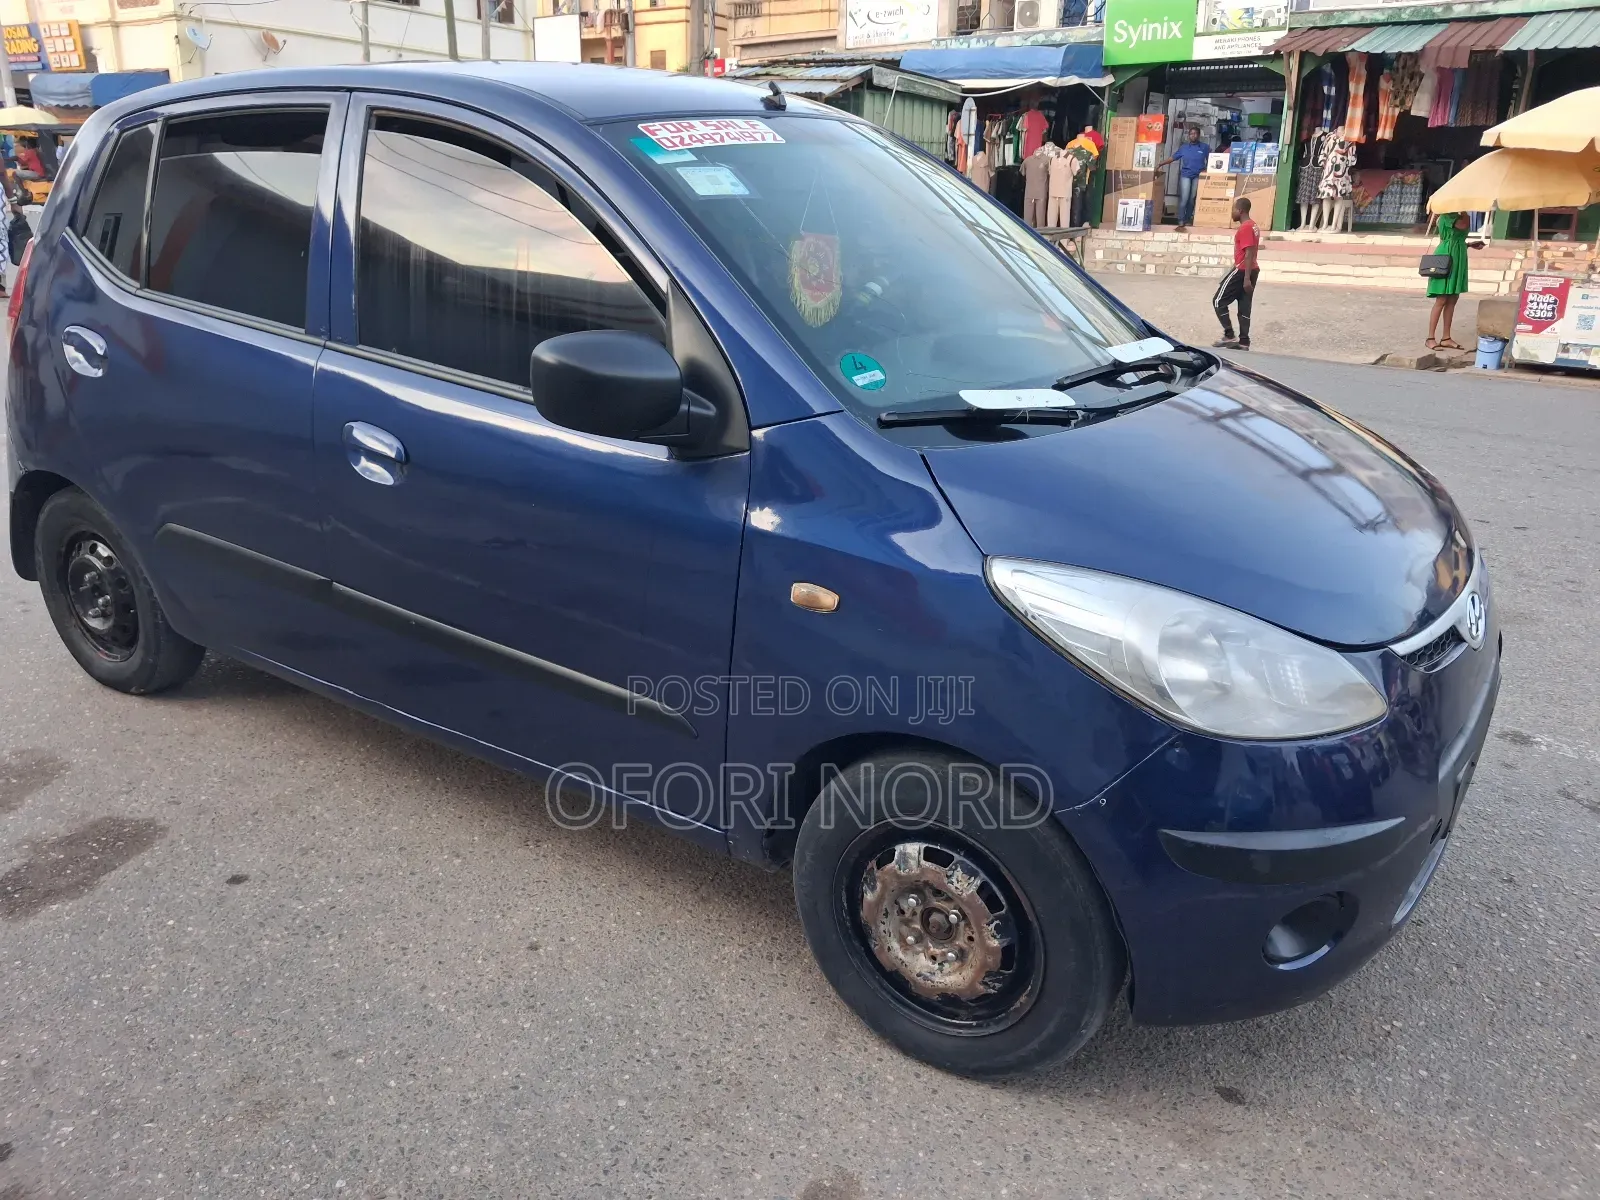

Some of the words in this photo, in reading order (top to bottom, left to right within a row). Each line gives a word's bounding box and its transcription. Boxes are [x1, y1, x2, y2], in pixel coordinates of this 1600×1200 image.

[875, 5, 904, 18] e-zwich
[1113, 15, 1183, 49] Syinix
[640, 121, 699, 137] FOR
[700, 120, 767, 131] SALE
[1528, 293, 1555, 303] Made
